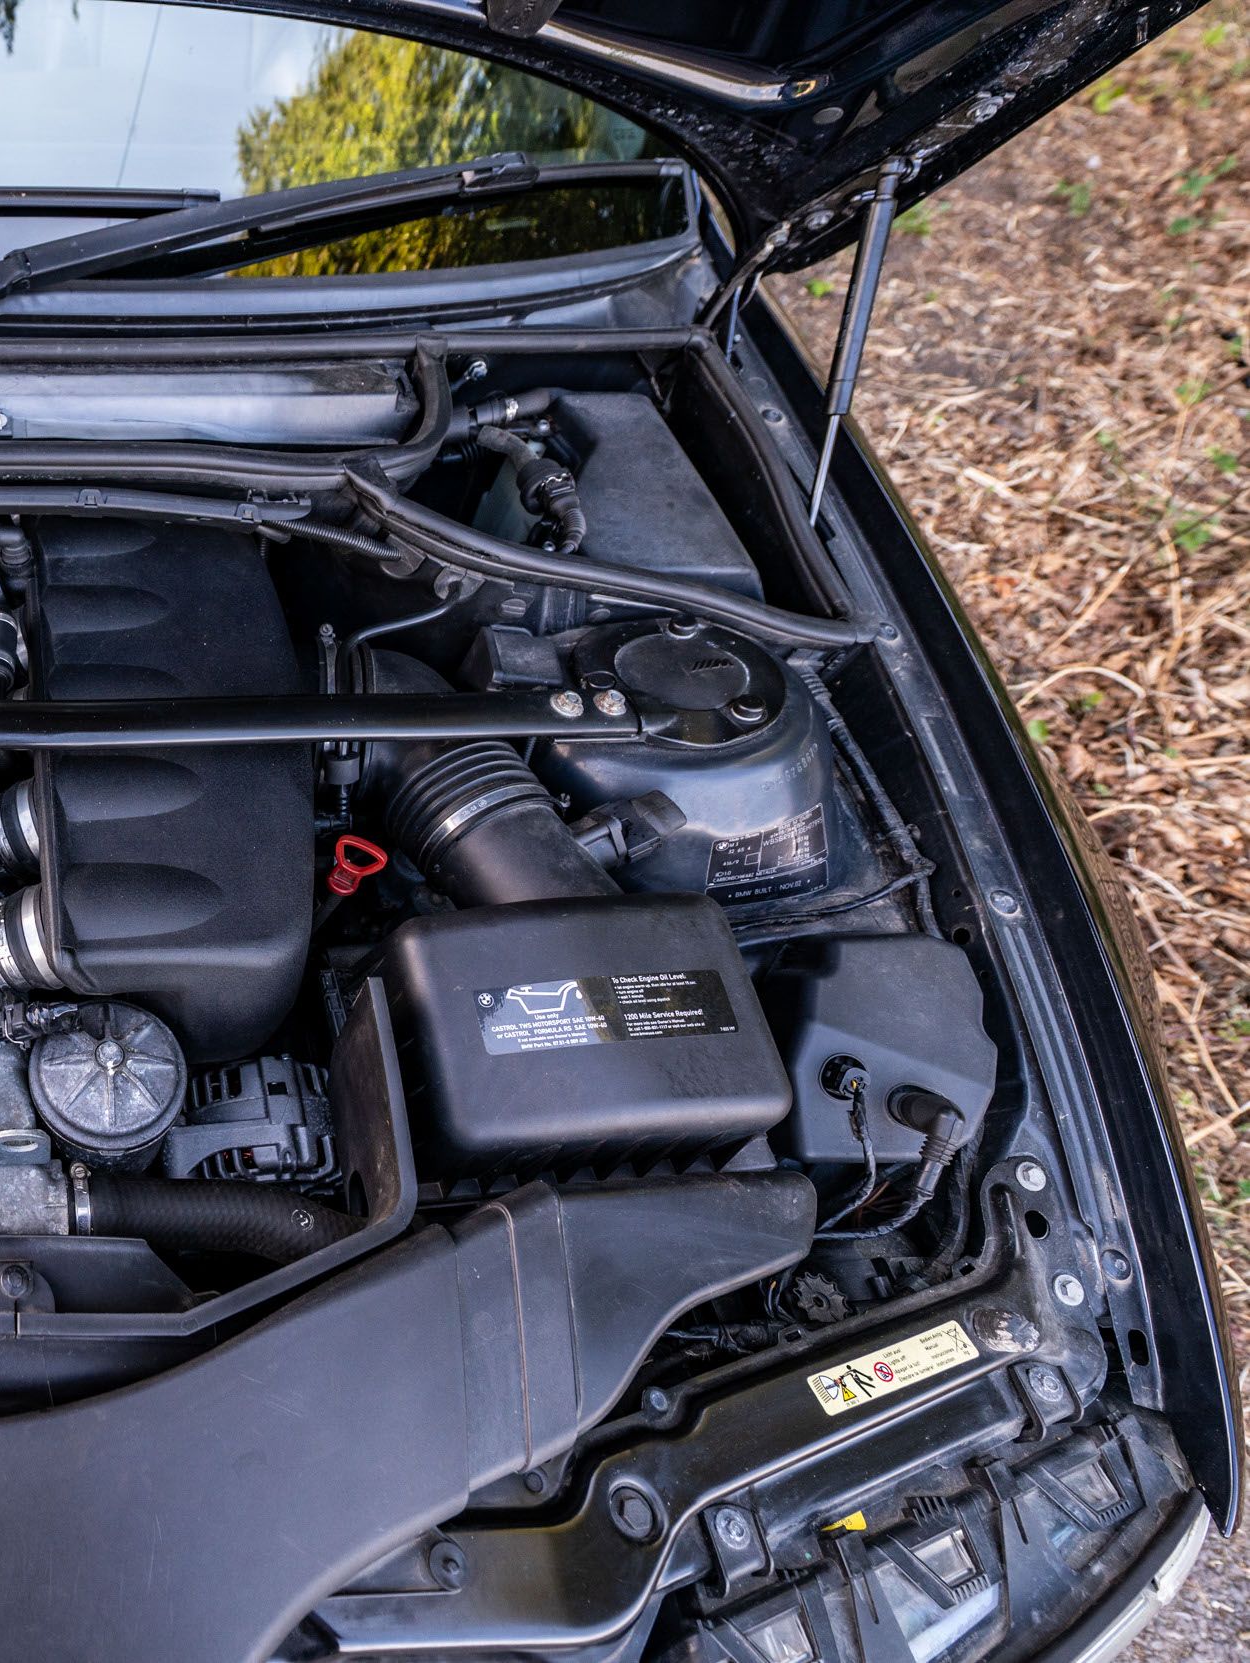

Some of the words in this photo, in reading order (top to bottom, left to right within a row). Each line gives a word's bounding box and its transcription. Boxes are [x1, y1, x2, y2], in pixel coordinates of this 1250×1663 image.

[735, 889, 752, 898] BMW
[754, 886, 771, 895] BUILT
[638, 975, 659, 983] Engine
[675, 1009, 703, 1017] Required!
[532, 1019, 572, 1027] MOTORSPORT
